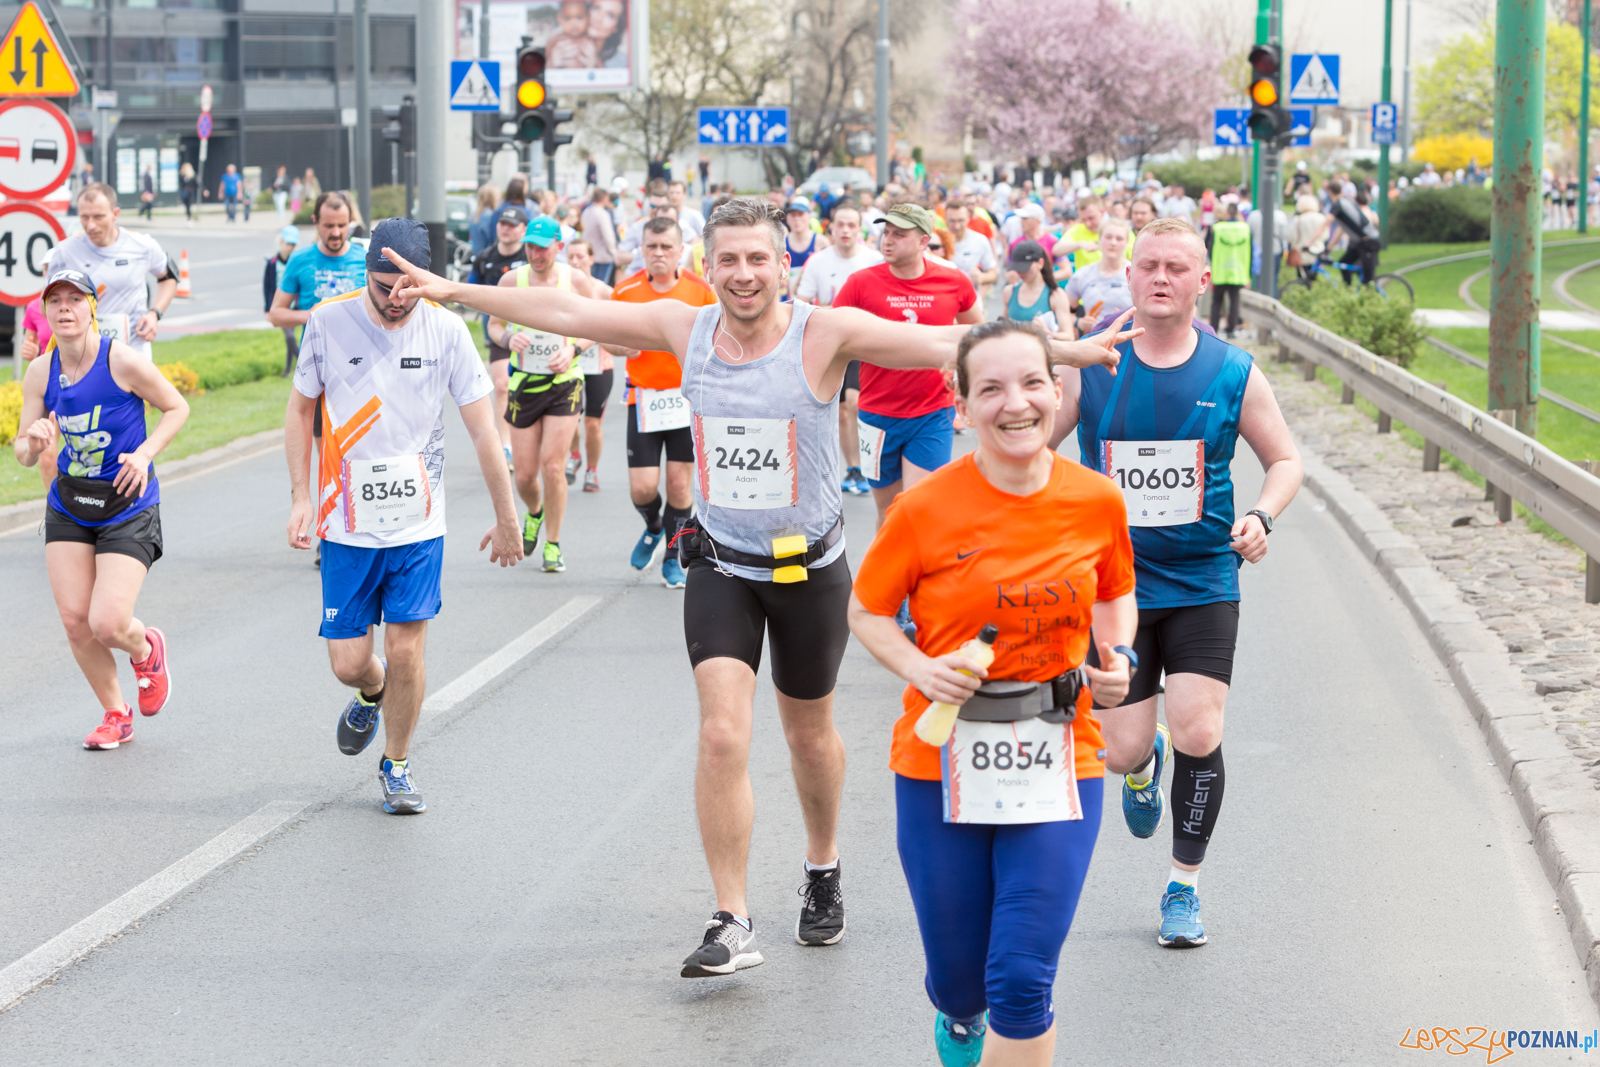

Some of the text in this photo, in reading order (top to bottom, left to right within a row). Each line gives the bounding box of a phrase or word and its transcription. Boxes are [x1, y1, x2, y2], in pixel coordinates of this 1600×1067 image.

[0, 231, 54, 277] 40
[650, 396, 684, 411] 6035
[715, 446, 780, 471] 2424
[362, 478, 417, 502] 8345
[735, 475, 758, 483] Adam
[1116, 467, 1196, 490] 10603
[375, 502, 406, 511] Sebastian
[995, 579, 1083, 613] KĘSY
[972, 741, 1053, 770] 8854
[997, 778, 1030, 786] Monika
[1182, 769, 1218, 834] Kalenji
